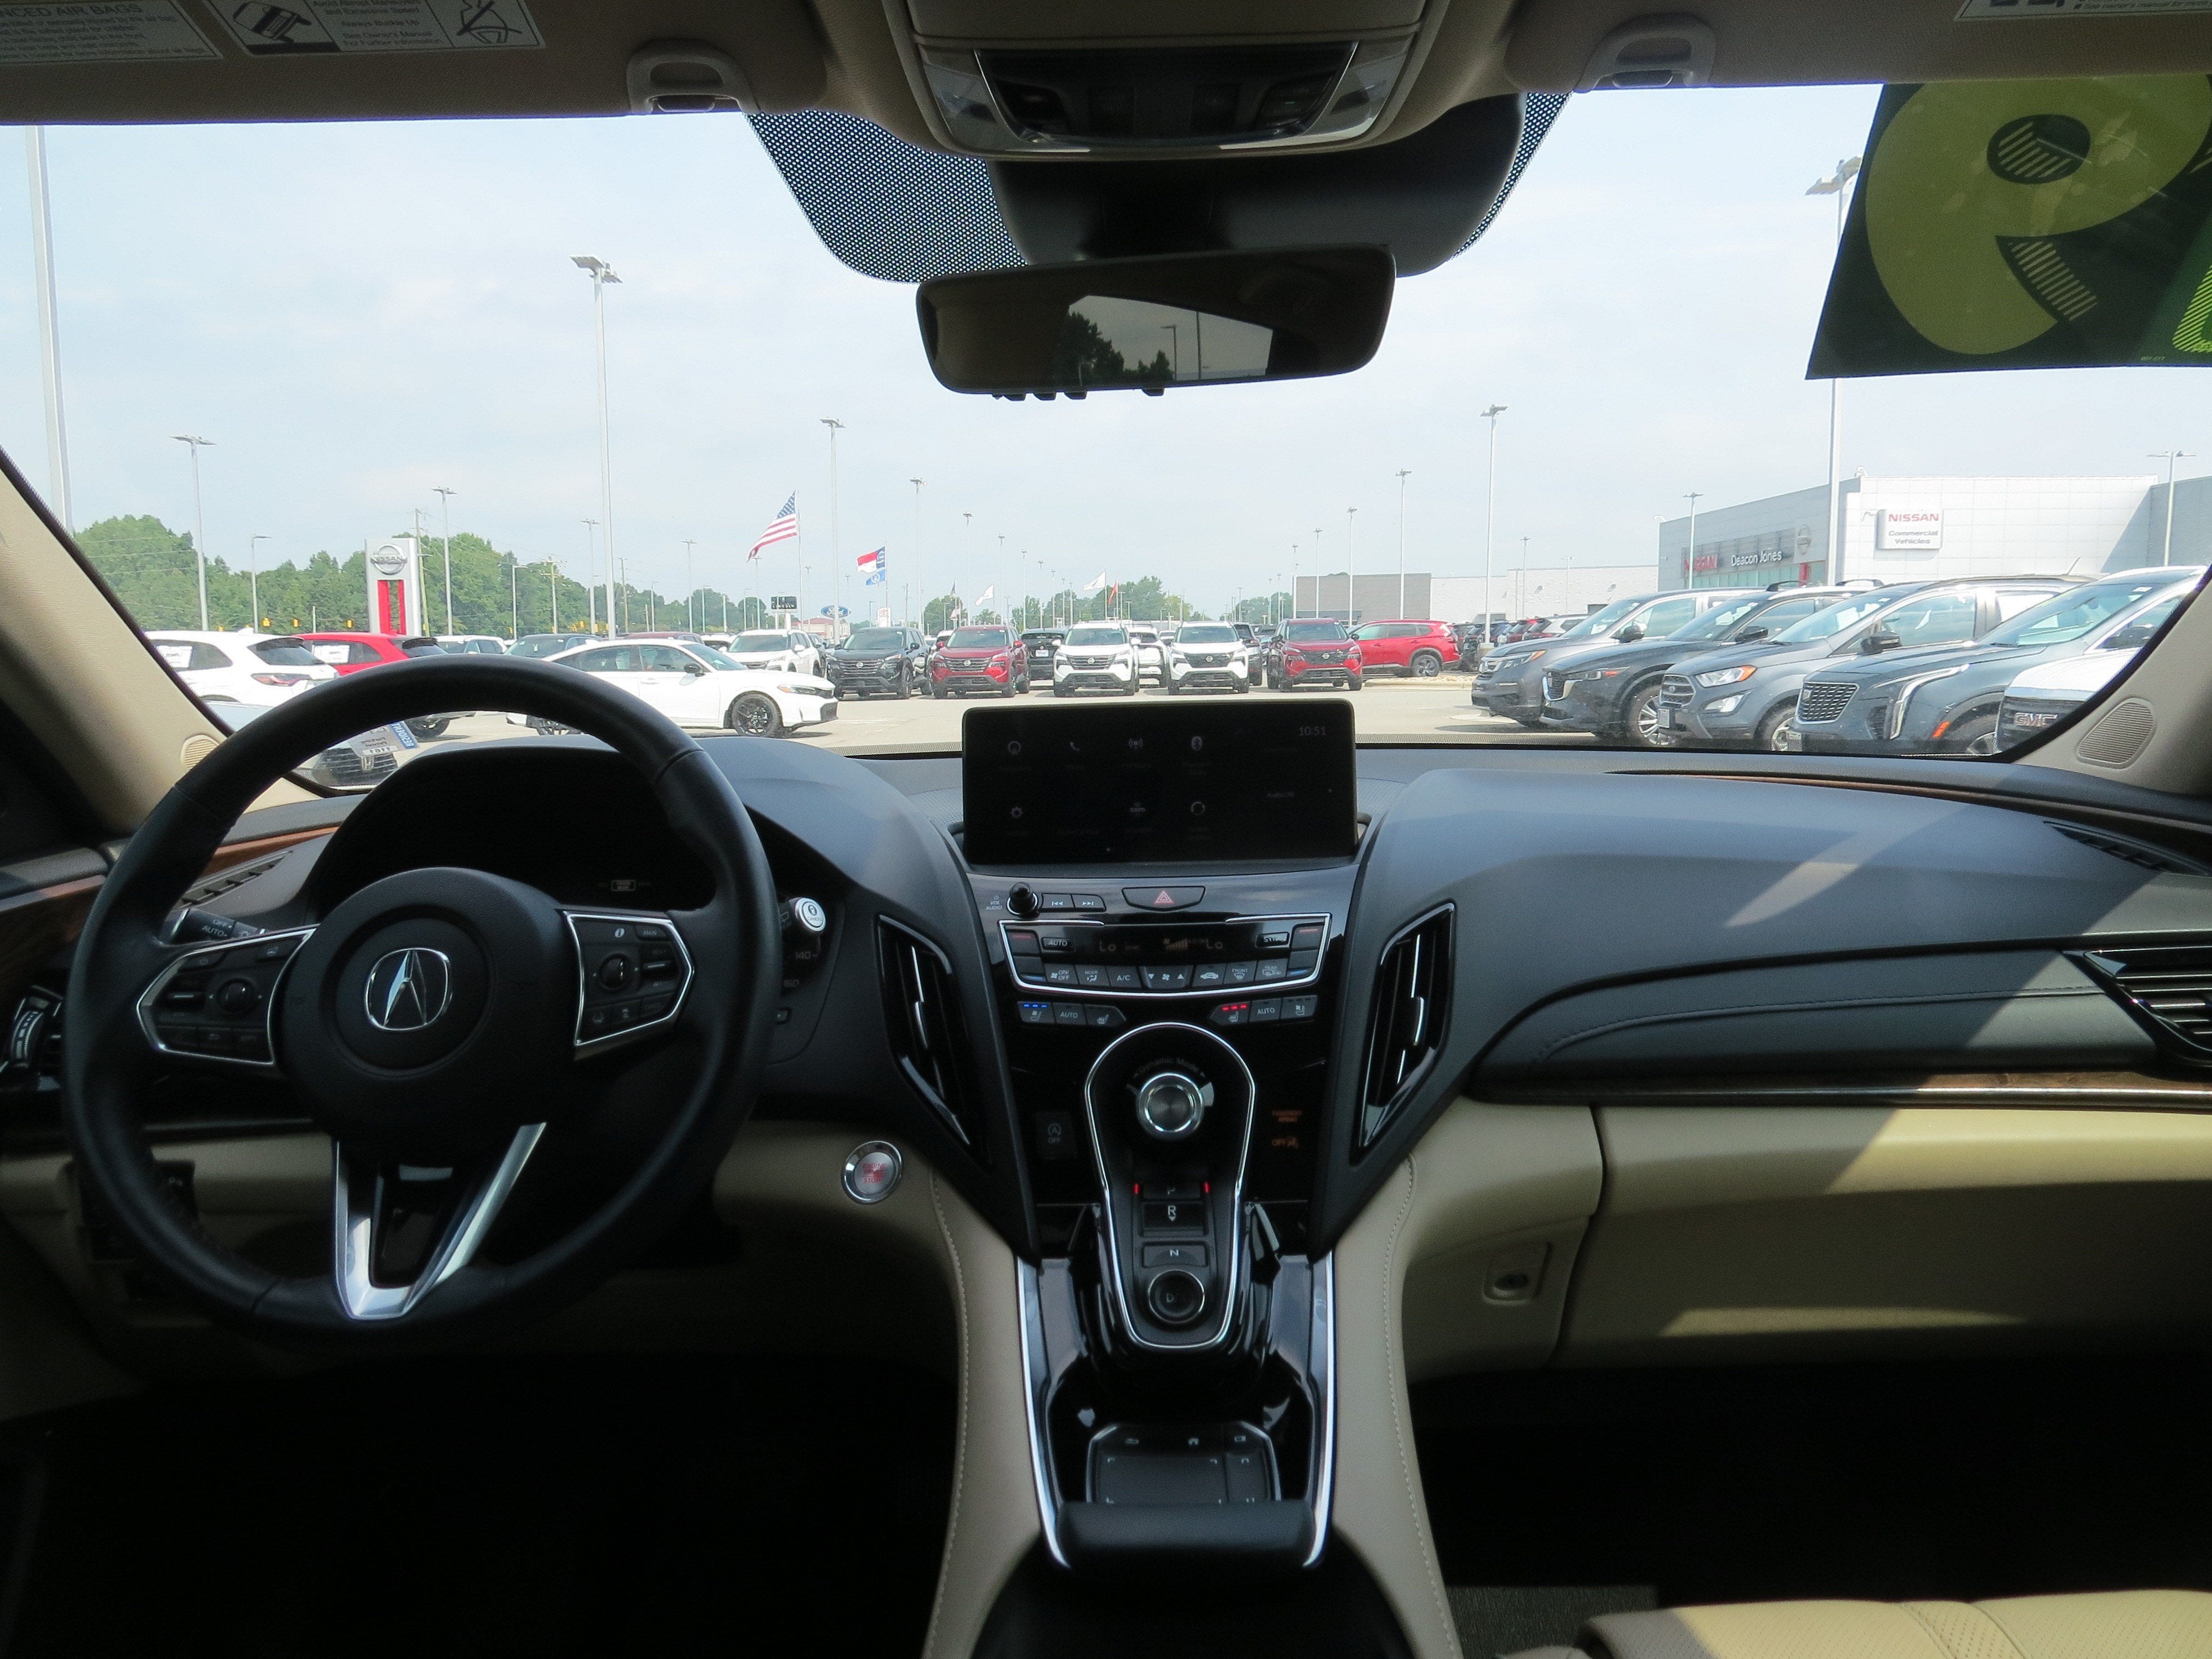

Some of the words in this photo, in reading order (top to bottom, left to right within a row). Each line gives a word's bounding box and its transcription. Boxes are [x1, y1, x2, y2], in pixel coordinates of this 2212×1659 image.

[56, 6, 87, 15] AIR
[90, 4, 143, 14] BAGS
[1731, 554, 1758, 567] Deacon
[1759, 551, 1783, 564] Jones
[2014, 712, 2058, 727] GMC
[1300, 726, 1326, 735] 10:51
[201, 925, 225, 937] AUTO
[796, 951, 811, 959] 140
[1140, 1057, 1173, 1071] Dynamic
[1177, 1057, 1199, 1071] Mode
[1272, 1138, 1286, 1146] OFF
[1168, 1206, 1176, 1215] R
[1166, 1293, 1175, 1302] D
